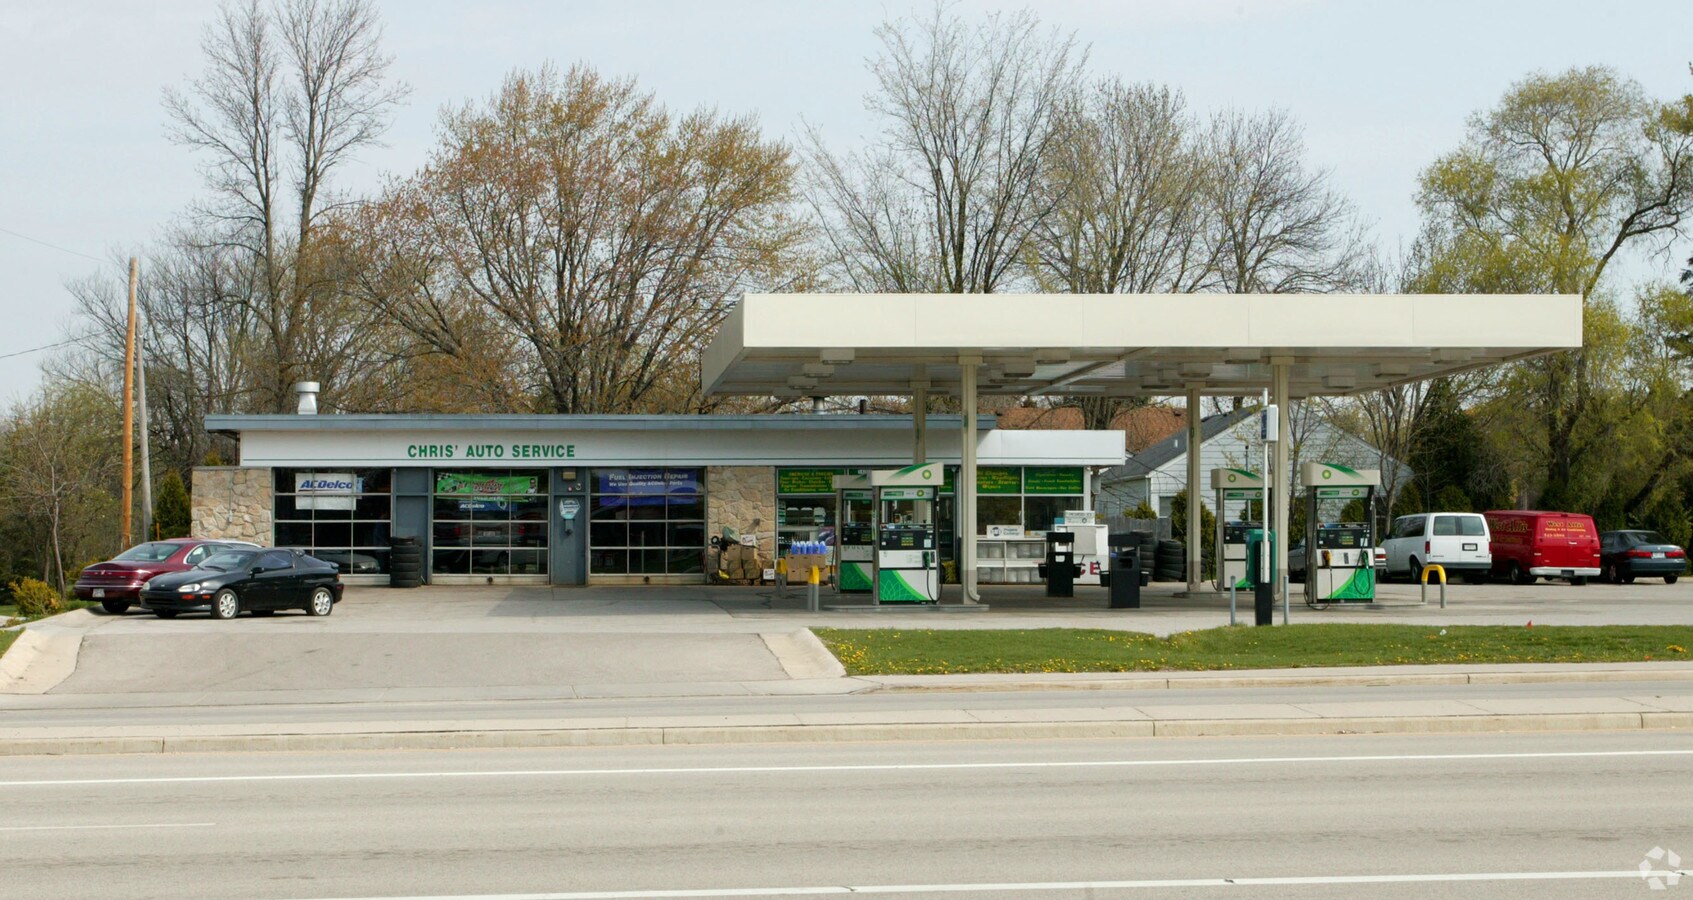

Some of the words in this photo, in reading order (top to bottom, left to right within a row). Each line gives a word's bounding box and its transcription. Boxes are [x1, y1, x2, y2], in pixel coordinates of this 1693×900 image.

[407, 445, 458, 458] CHRIS'
[466, 445, 504, 458] AUTO
[512, 445, 575, 458] SERVICE
